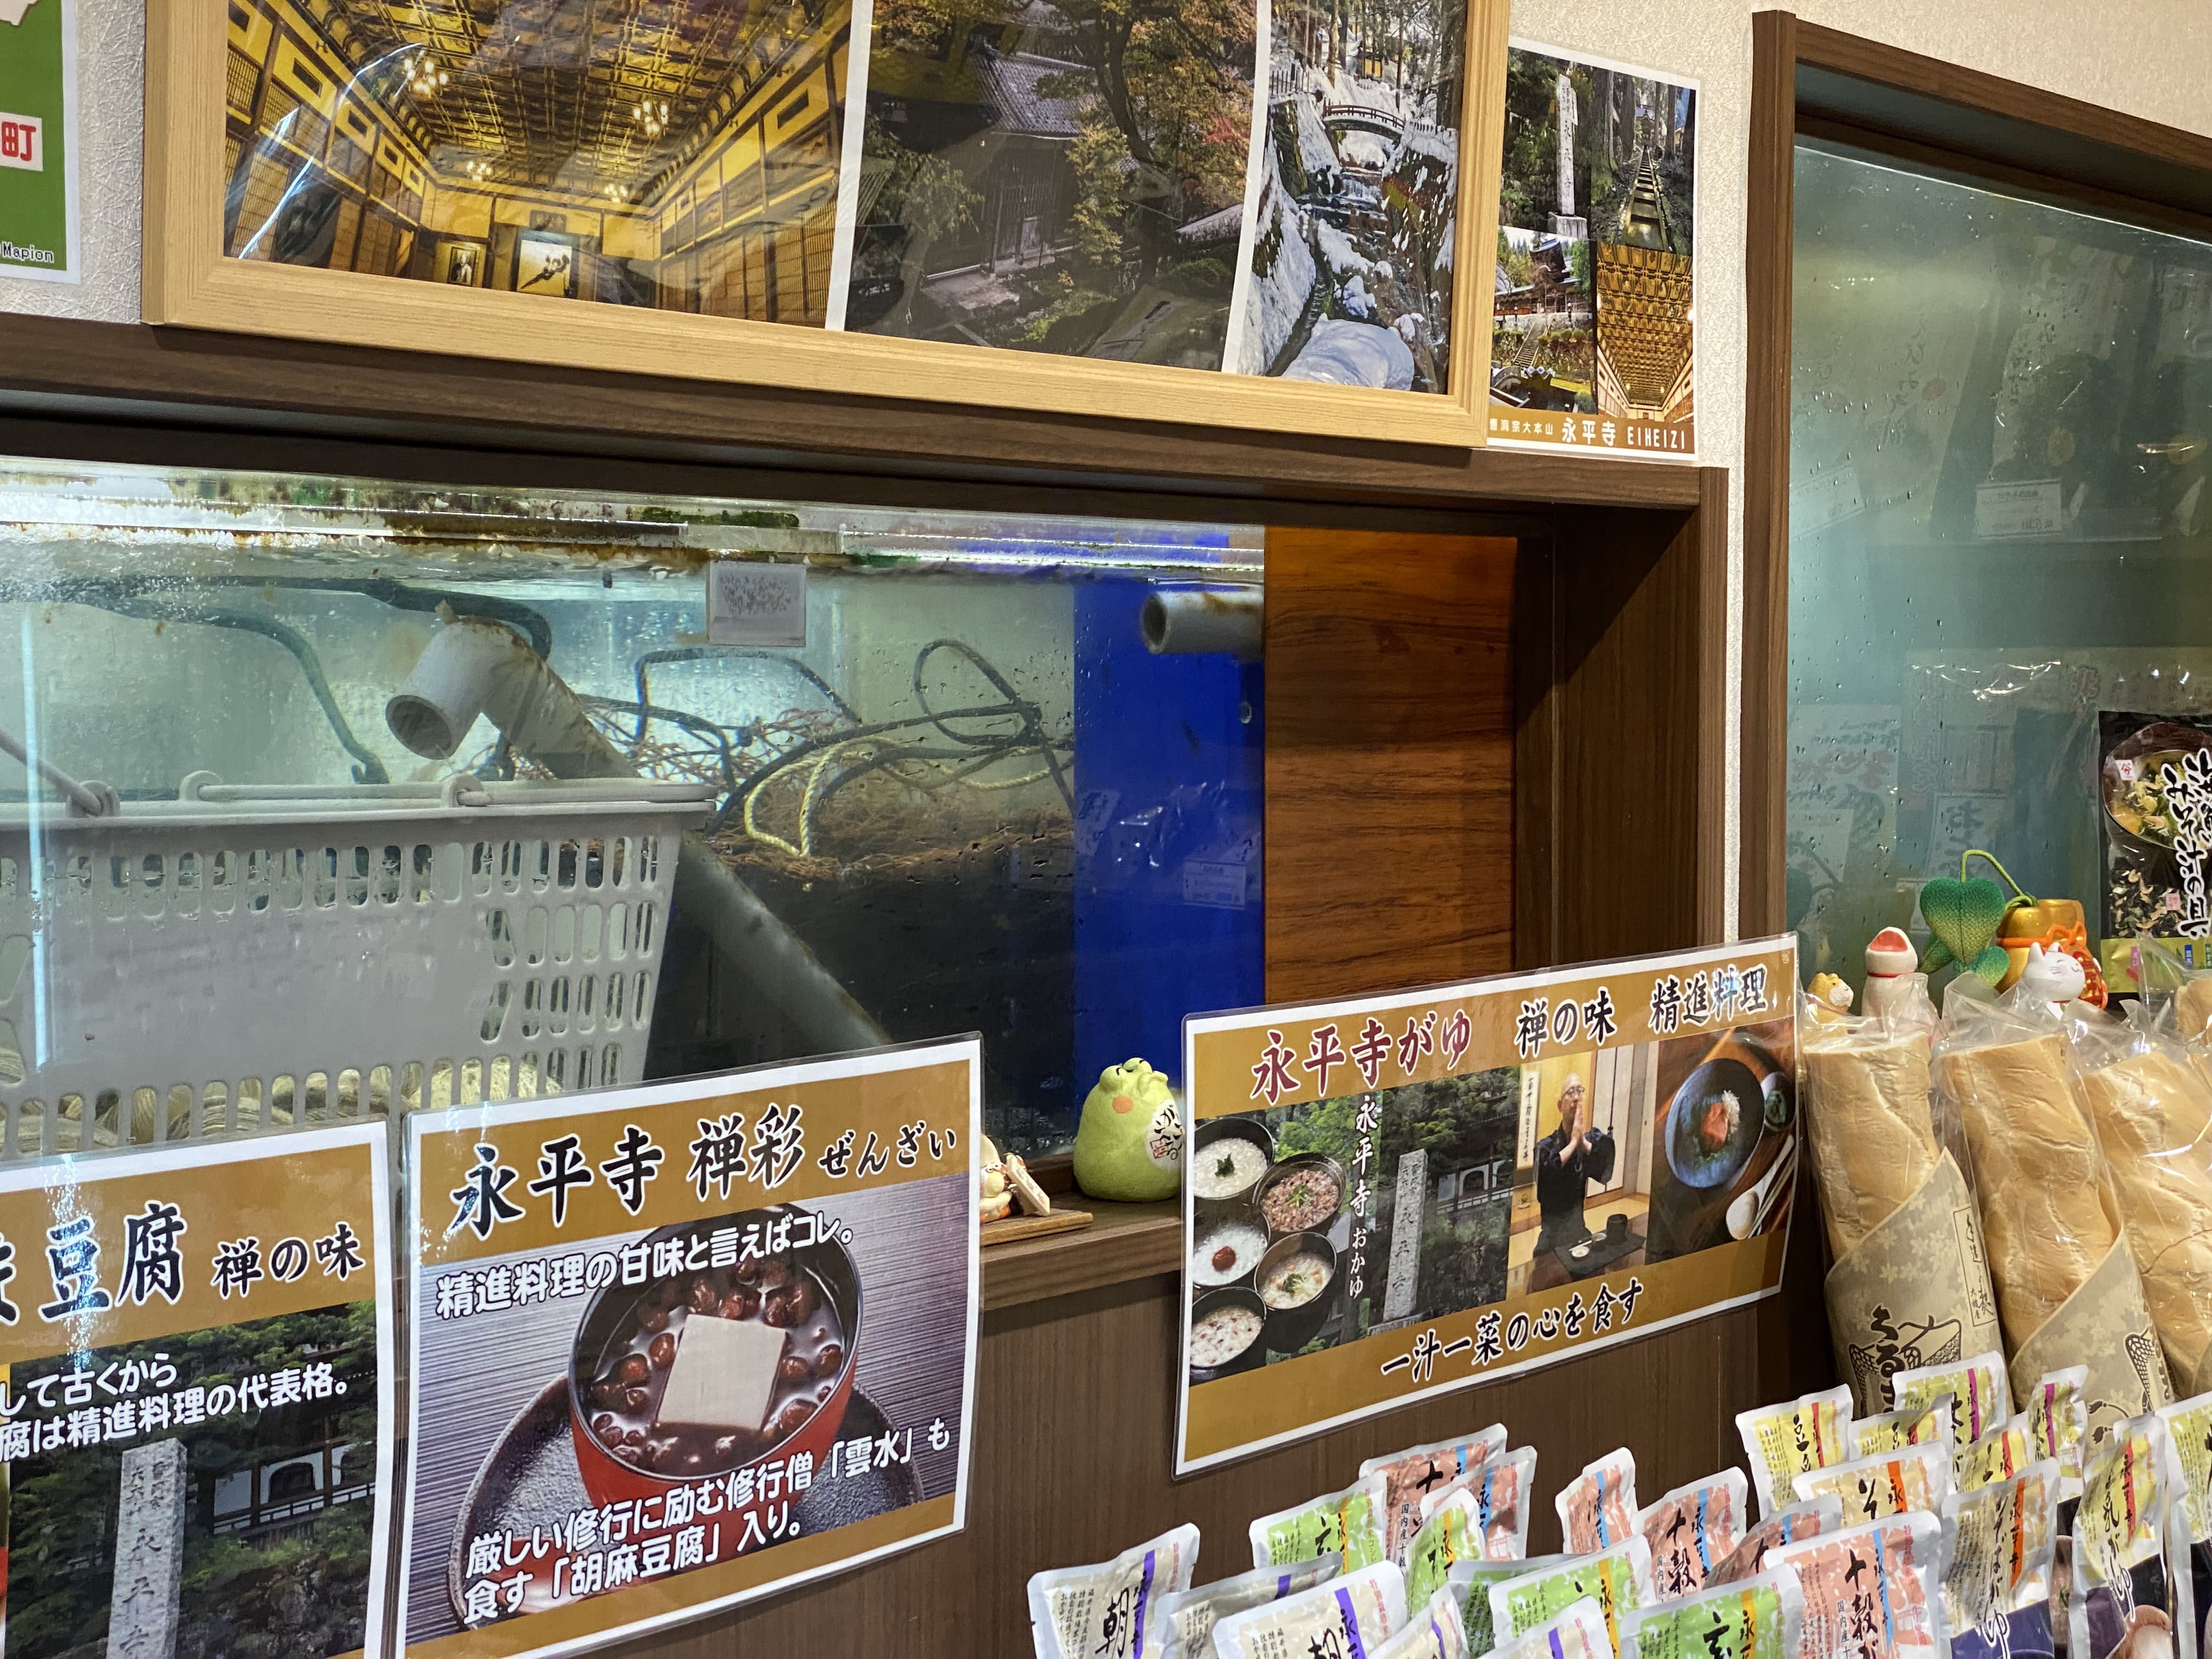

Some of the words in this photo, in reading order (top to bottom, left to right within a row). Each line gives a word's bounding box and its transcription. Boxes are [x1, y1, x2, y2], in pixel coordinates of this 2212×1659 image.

[1, 121, 36, 162] 町
[2, 243, 54, 264] Mapion
[1562, 417, 1616, 447] 永平寺
[1627, 426, 1685, 449] EIHEIZI
[1250, 1009, 1472, 1104] 永平寺がゆ
[1515, 987, 1616, 1058] 禅の味
[1649, 966, 1767, 1034] 精進料理
[447, 1125, 665, 1240] 永平寺
[686, 1103, 805, 1201] 禅彩
[819, 1121, 957, 1179] ぜんざい
[1350, 1094, 1379, 1217] 永平寺
[0, 1201, 185, 1325] 豆腐
[211, 1222, 365, 1300] 禅の味
[436, 1211, 854, 1320] 精進料理の甘味と言えばコレ。
[1349, 1227, 1367, 1299] おかゆ
[1380, 1277, 1645, 1383] 一汁一菜の心を食す
[0, 1353, 177, 1417] して古くから
[0, 1363, 347, 1462] 腐は精進料理の代表格。
[465, 1417, 951, 1578] 厳しい修行に励む修行僧「雲水」も
[463, 1506, 800, 1624] 食す「胡麻豆腐」入り。
